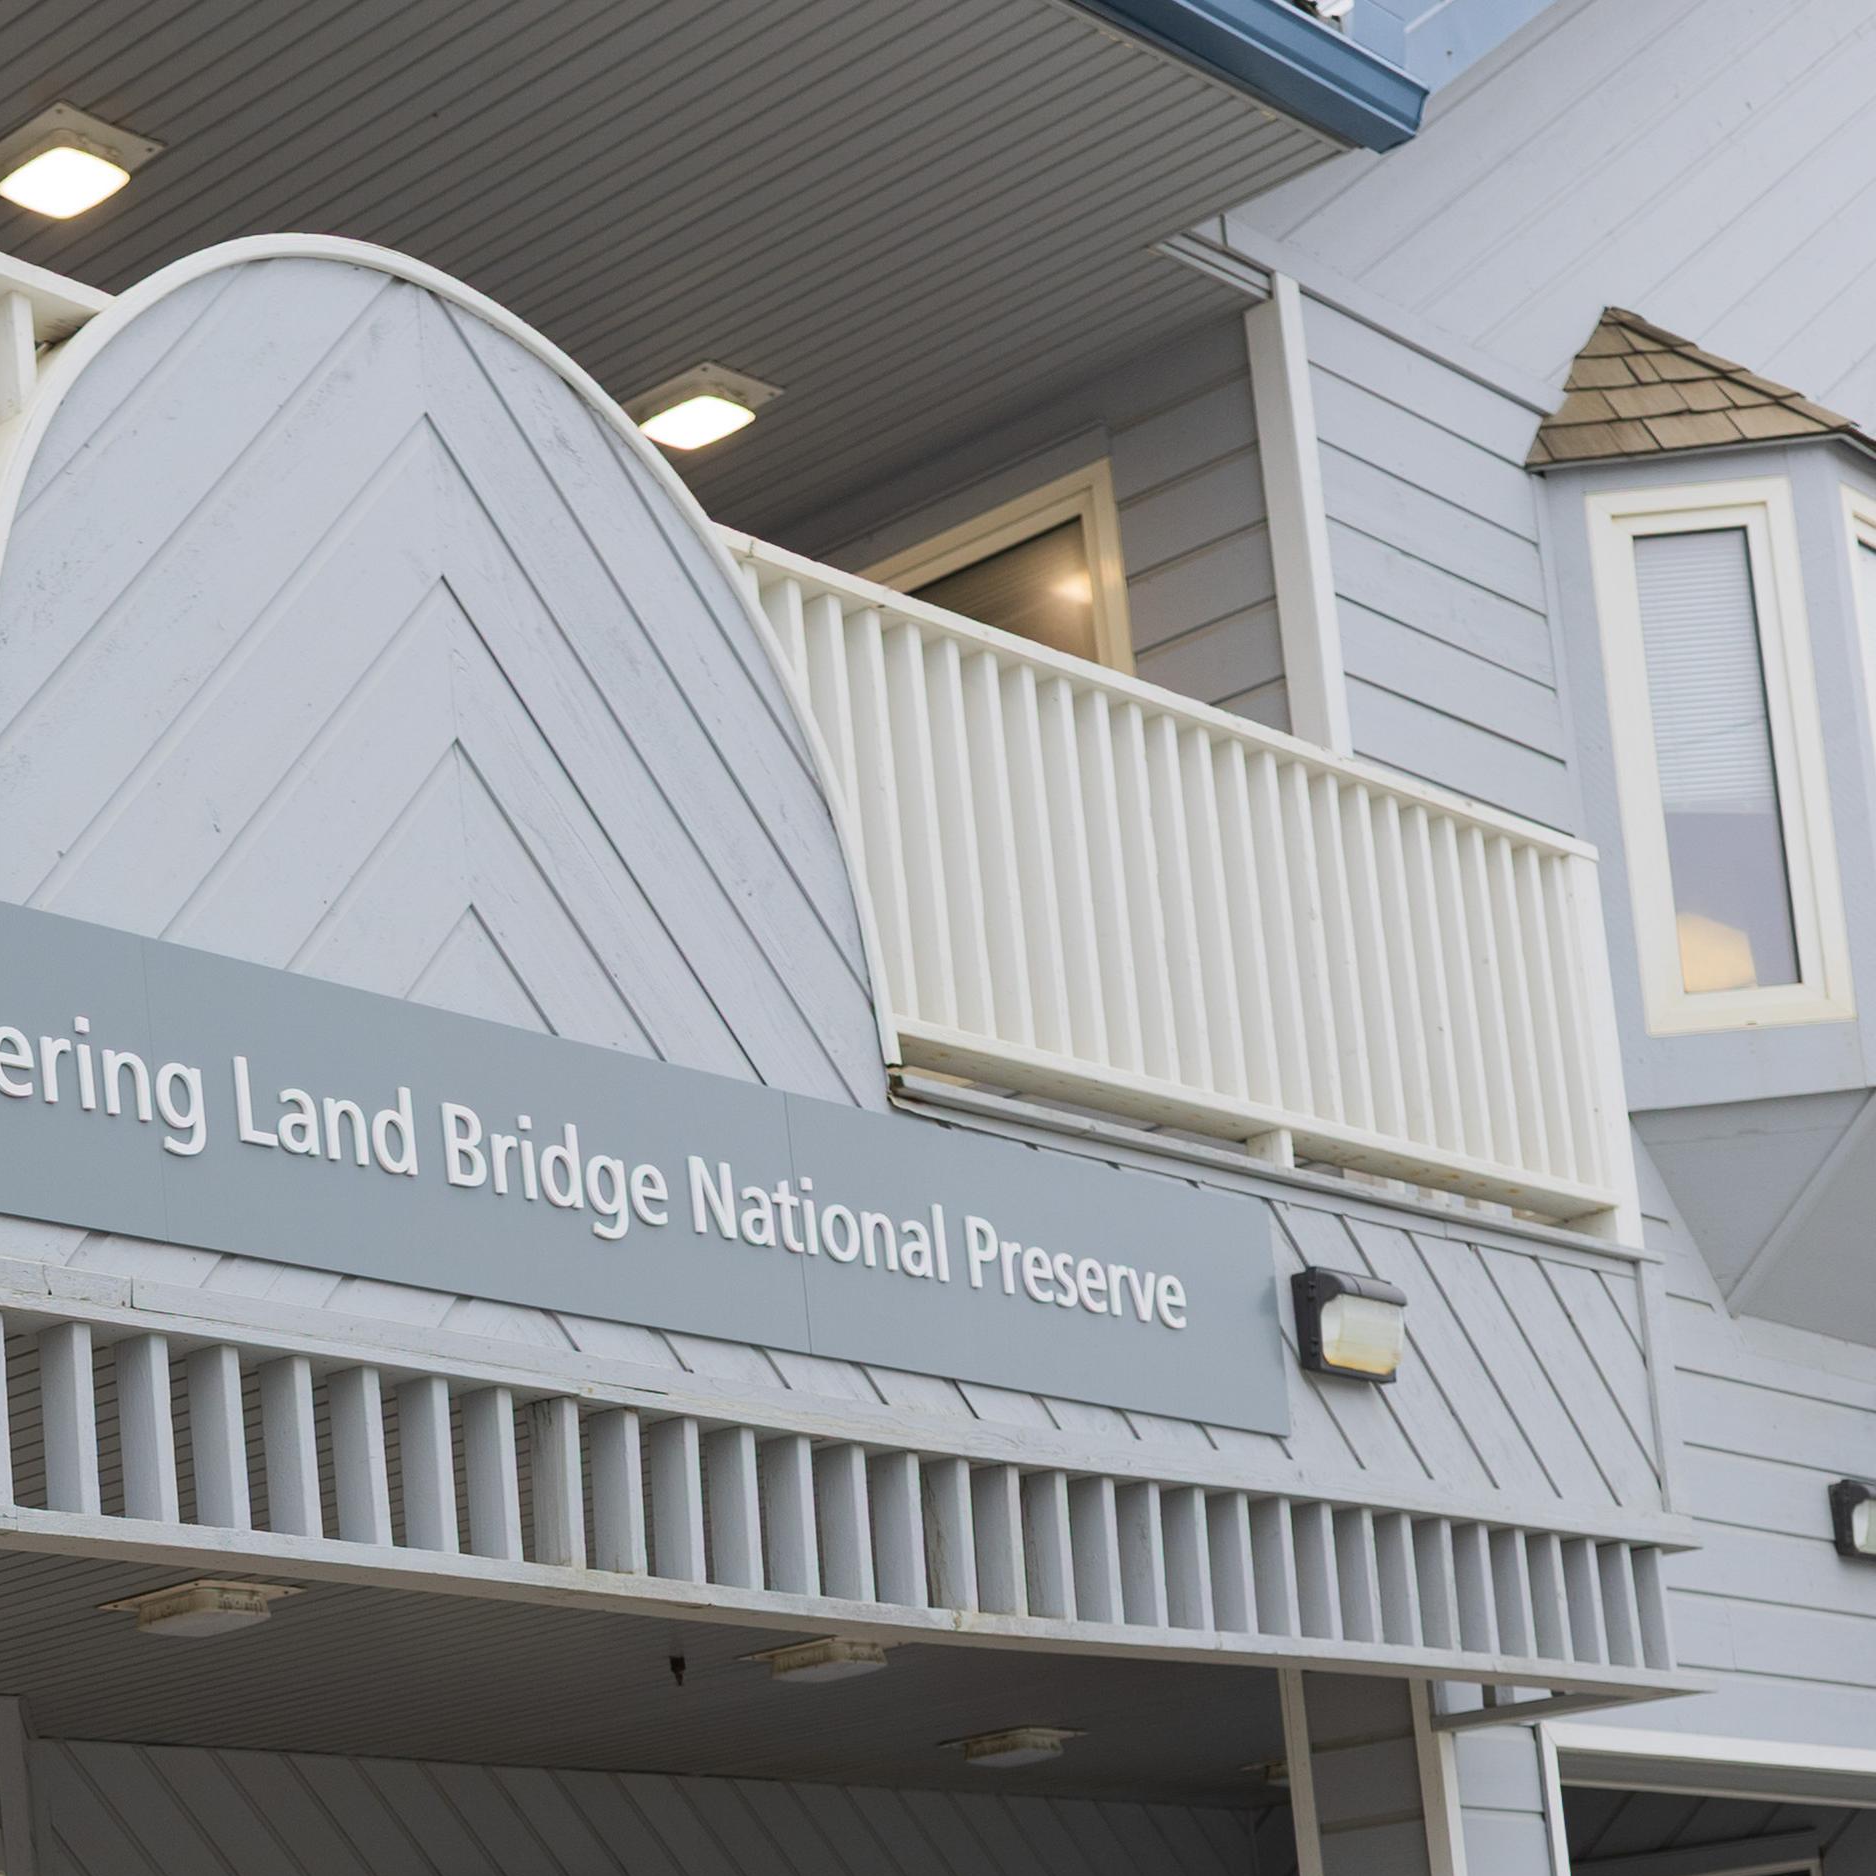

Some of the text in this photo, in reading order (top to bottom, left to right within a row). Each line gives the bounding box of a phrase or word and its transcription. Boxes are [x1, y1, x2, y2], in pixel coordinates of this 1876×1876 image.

[233, 1055, 419, 1177] Land
[440, 1102, 669, 1240] Bridge
[687, 1155, 950, 1283] National
[964, 1214, 1187, 1329] Preserve
